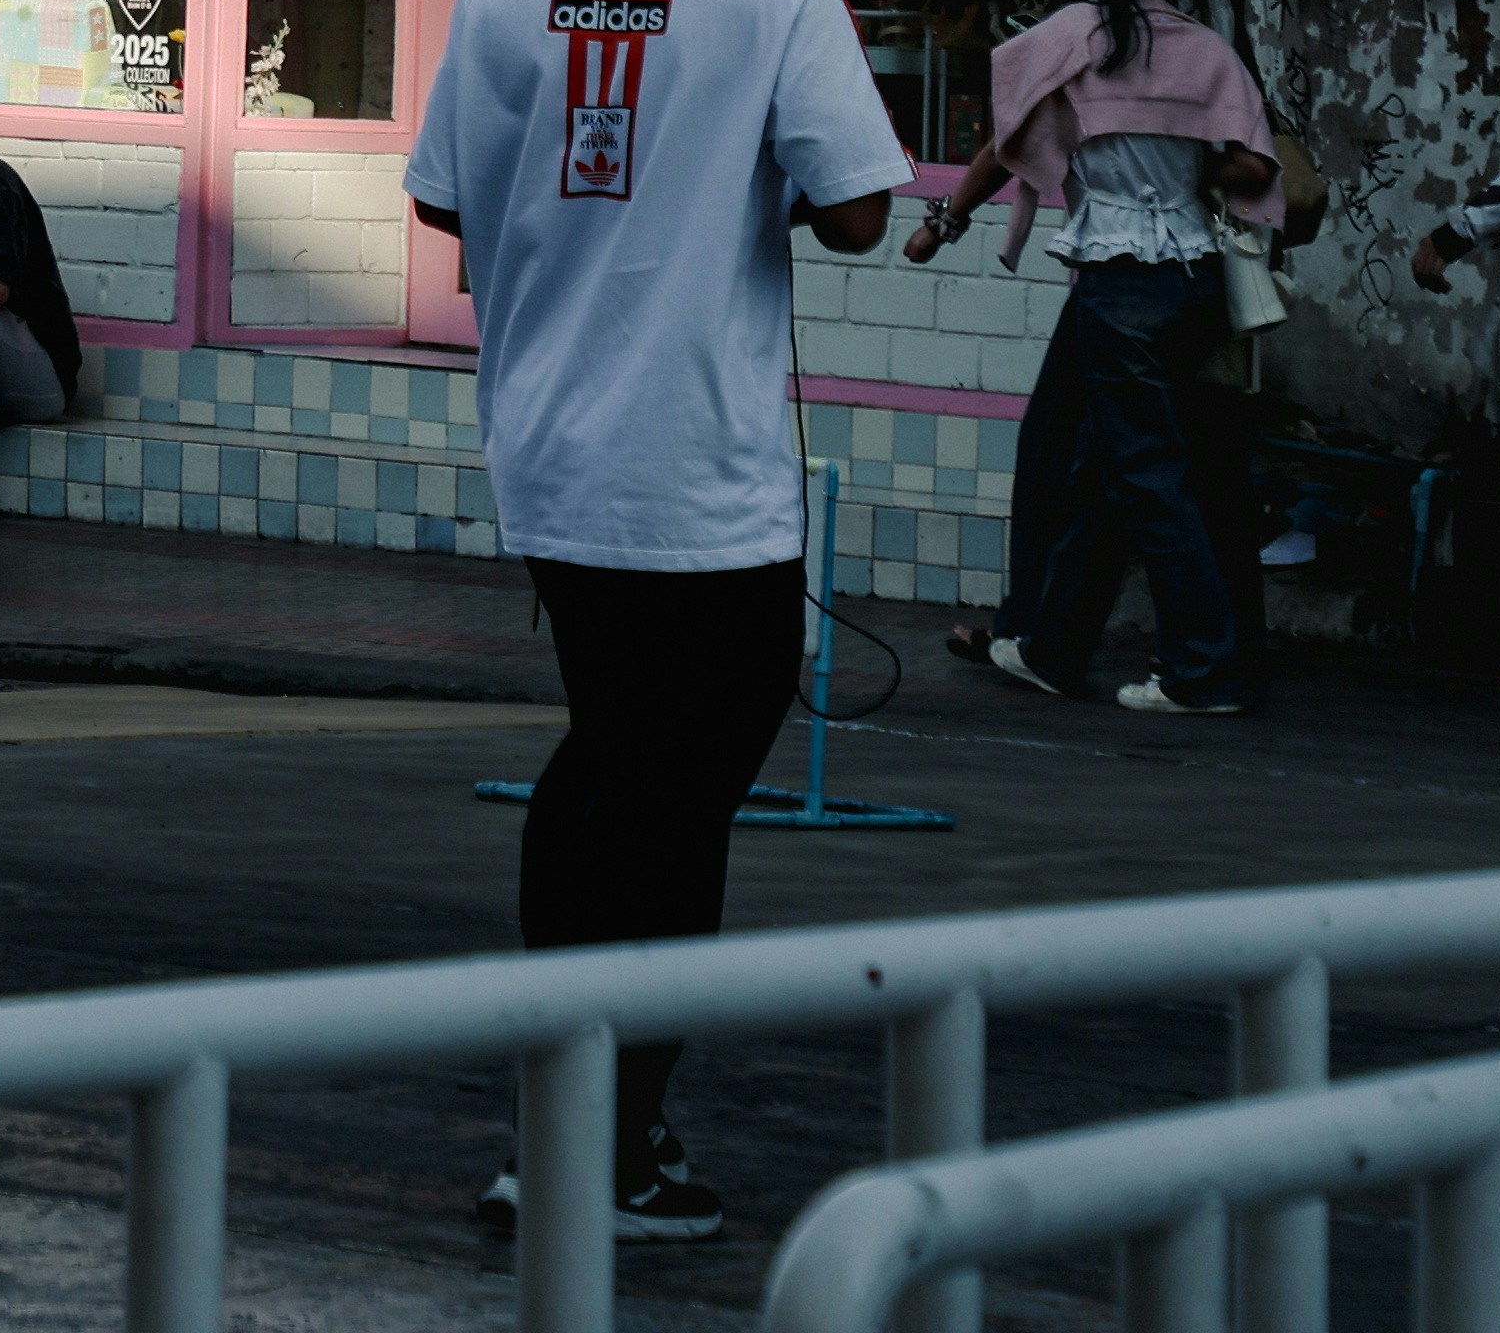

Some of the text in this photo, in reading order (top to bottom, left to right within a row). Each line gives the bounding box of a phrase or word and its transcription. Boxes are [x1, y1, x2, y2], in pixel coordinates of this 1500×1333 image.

[554, 0, 665, 31] adidas
[110, 33, 170, 67] 2025
[126, 68, 171, 84] COLLECTION
[582, 113, 623, 126] BRAND
